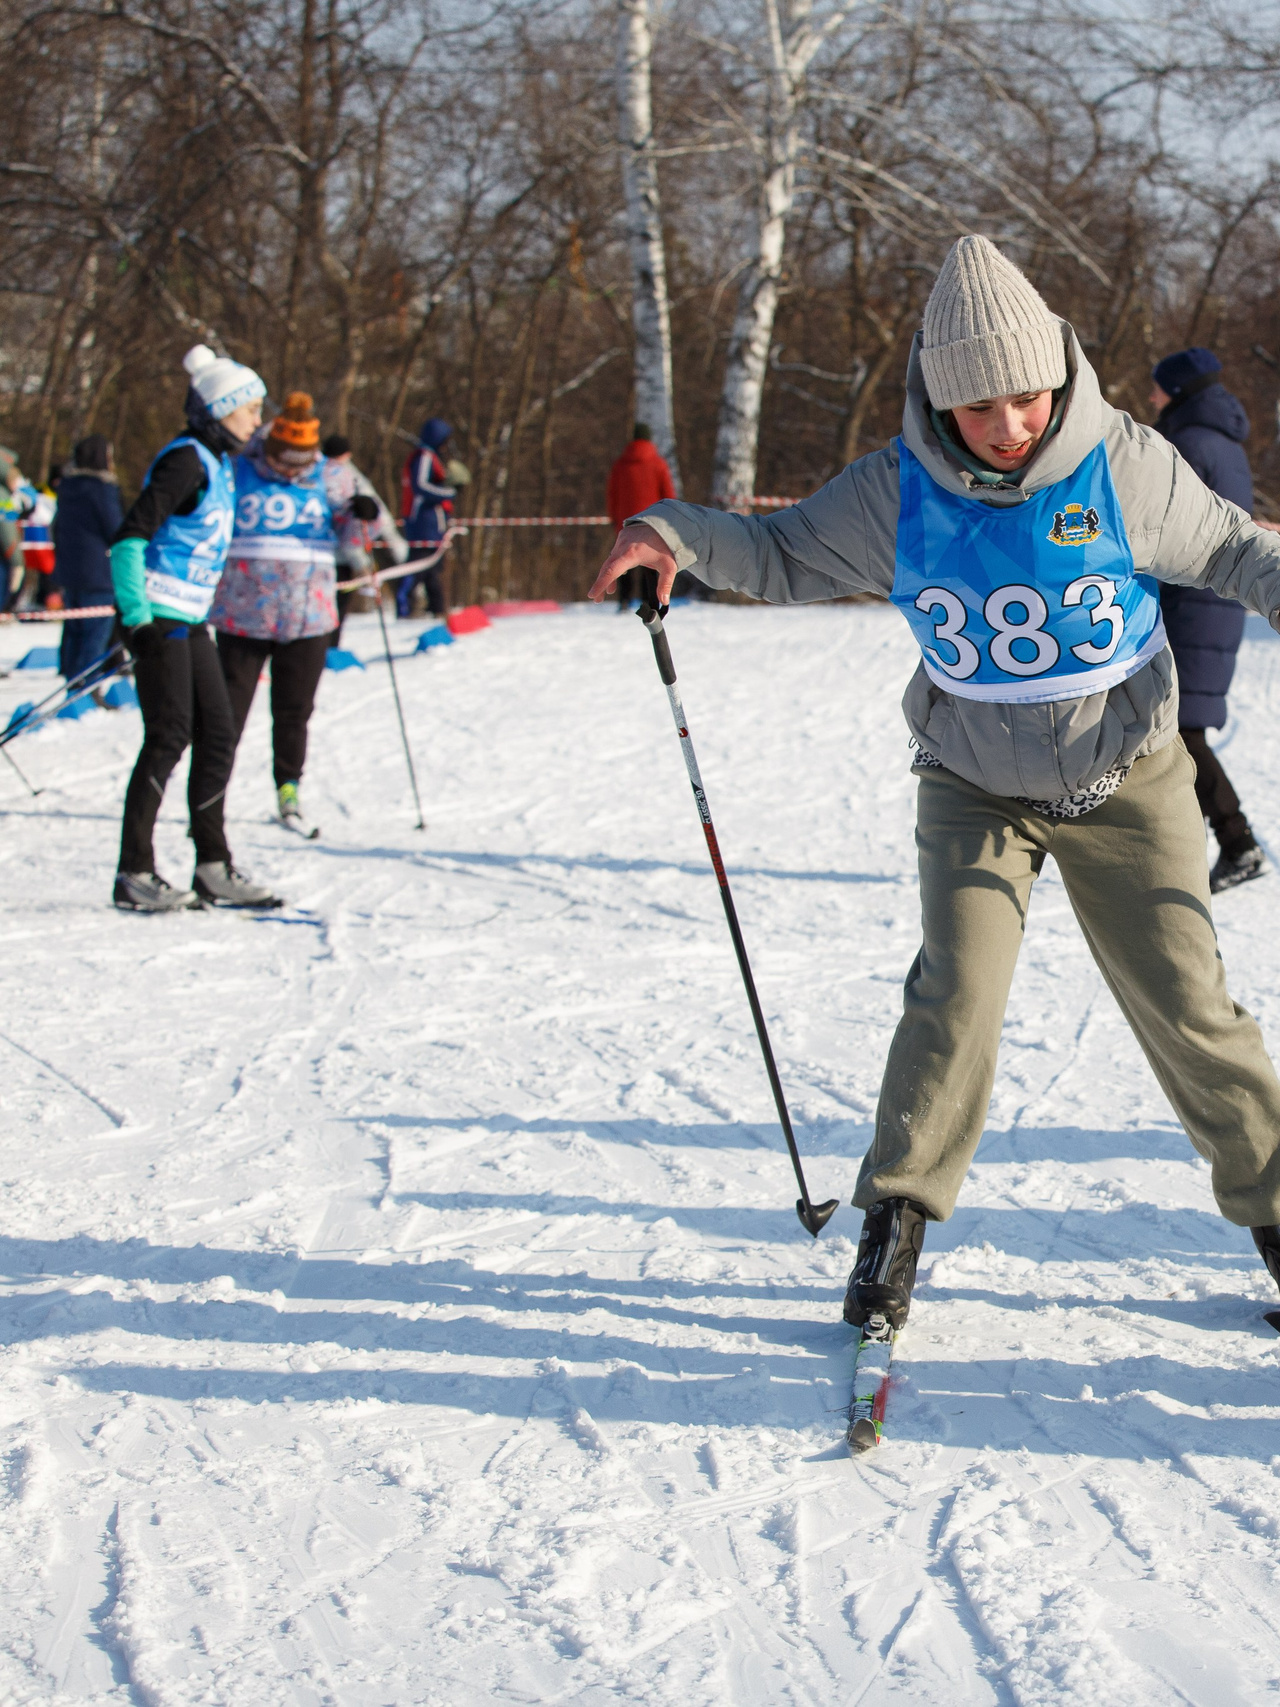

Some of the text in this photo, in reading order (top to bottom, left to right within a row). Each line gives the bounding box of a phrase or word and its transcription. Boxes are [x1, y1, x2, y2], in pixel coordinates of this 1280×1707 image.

[235, 492, 325, 532] 394
[914, 574, 1126, 680] 383
[696, 789, 704, 799] 30
[699, 800, 712, 824] CLASSIC
